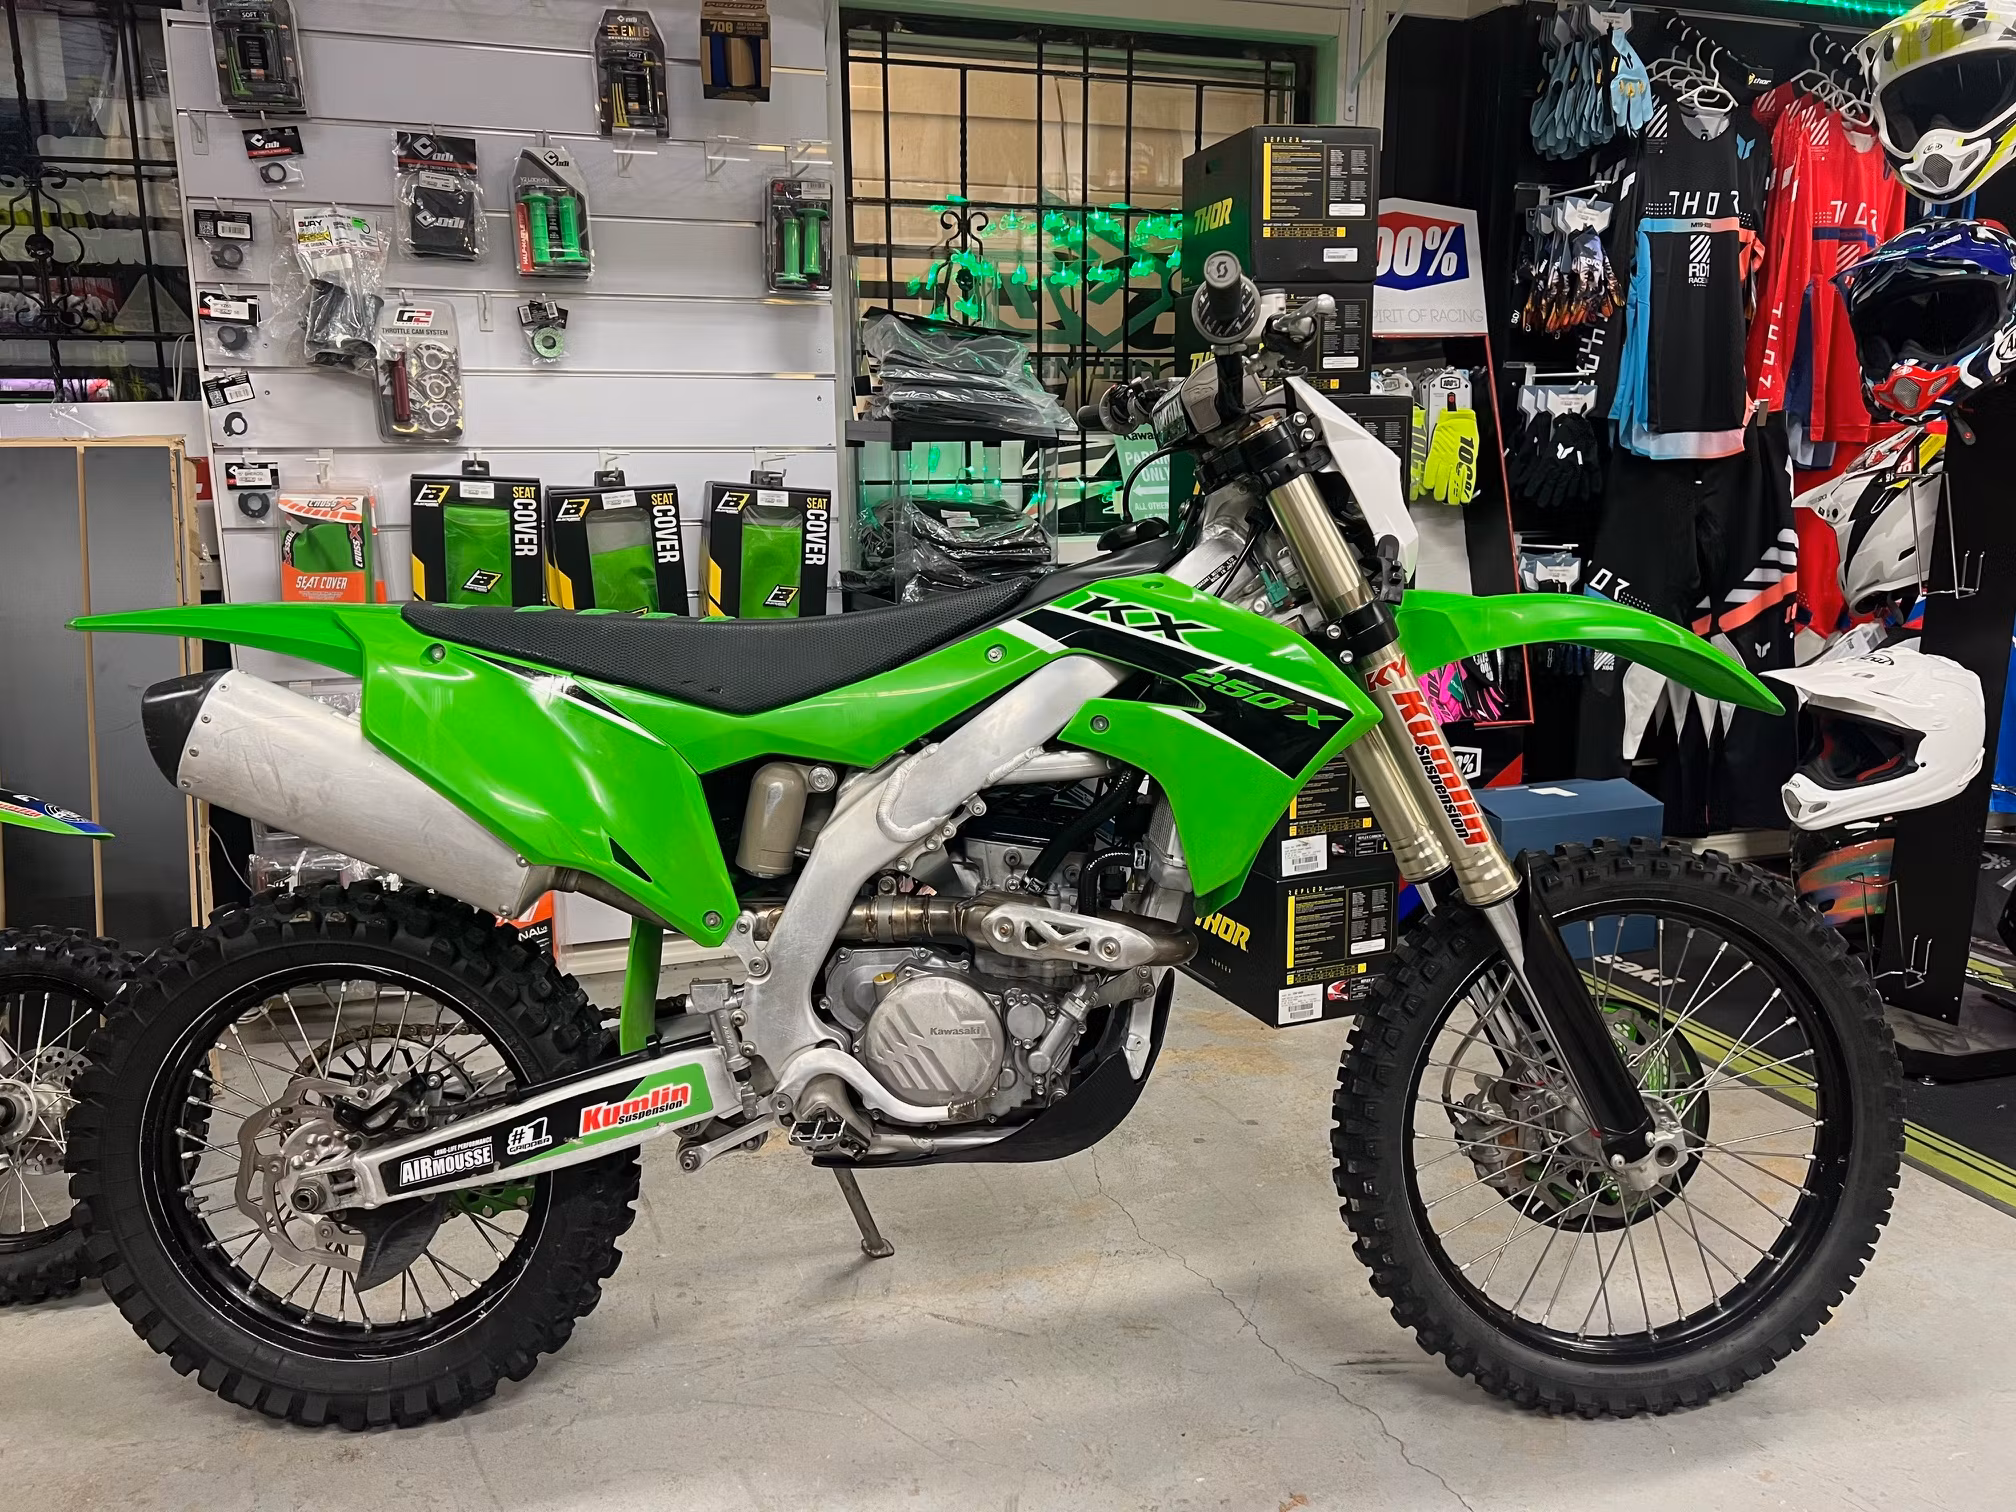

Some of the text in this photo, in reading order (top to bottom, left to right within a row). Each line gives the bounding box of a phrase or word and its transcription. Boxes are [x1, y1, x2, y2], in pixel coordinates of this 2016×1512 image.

[1194, 197, 1233, 236] THOR
[1376, 226, 1459, 277] 00%
[382, 327, 411, 335] THROTTLE
[1372, 309, 1484, 323] PIRIT OF RACING
[512, 486, 536, 499] SEAT
[651, 493, 674, 505] SEAT
[806, 497, 828, 510] SEAT
[513, 499, 538, 556] COVER
[652, 505, 680, 563] COVER
[804, 509, 828, 566] COVER
[295, 576, 348, 590] SEAT COVER
[1067, 590, 1222, 649] KX
[1392, 690, 1490, 846] Kumlin
[1414, 744, 1471, 839] Suspension
[1382, 841, 1389, 851] L
[1594, 954, 1687, 987] saki
[929, 1026, 981, 1036] Kawasaki
[582, 1085, 690, 1134] Kumlin
[618, 1100, 683, 1125] Suspension
[457, 1136, 493, 1151] PERFORMANCE
[509, 1117, 548, 1146] #1
[401, 1146, 492, 1184] AIRMOUSSE
